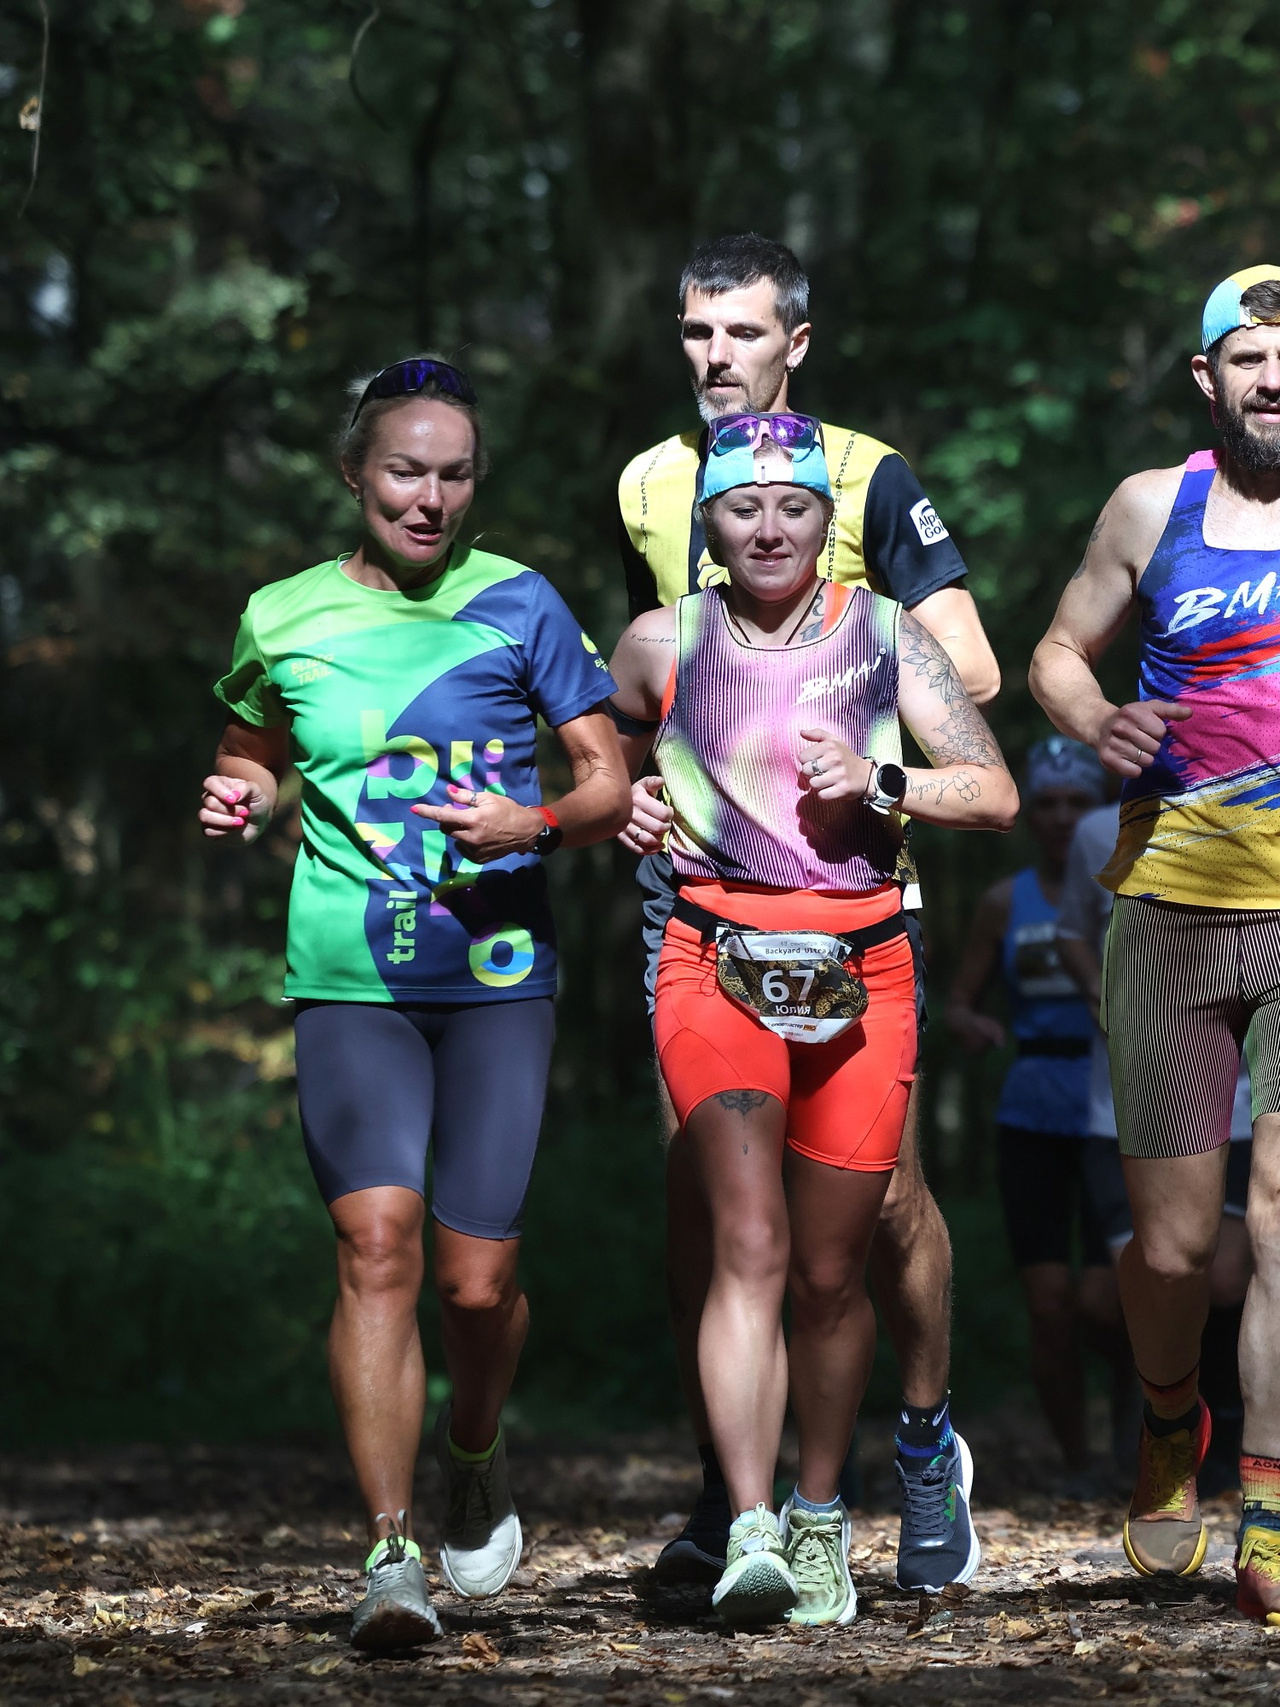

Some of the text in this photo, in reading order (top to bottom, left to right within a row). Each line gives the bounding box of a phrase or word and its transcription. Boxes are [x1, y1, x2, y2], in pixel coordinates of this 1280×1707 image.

[827, 509, 838, 583] ВЛАДИМИРСКИ
[924, 521, 944, 539] Gol
[790, 655, 881, 708] BMAI
[386, 889, 418, 965] trail
[765, 947, 827, 956] Backyard Ultra
[762, 969, 815, 1003] 67
